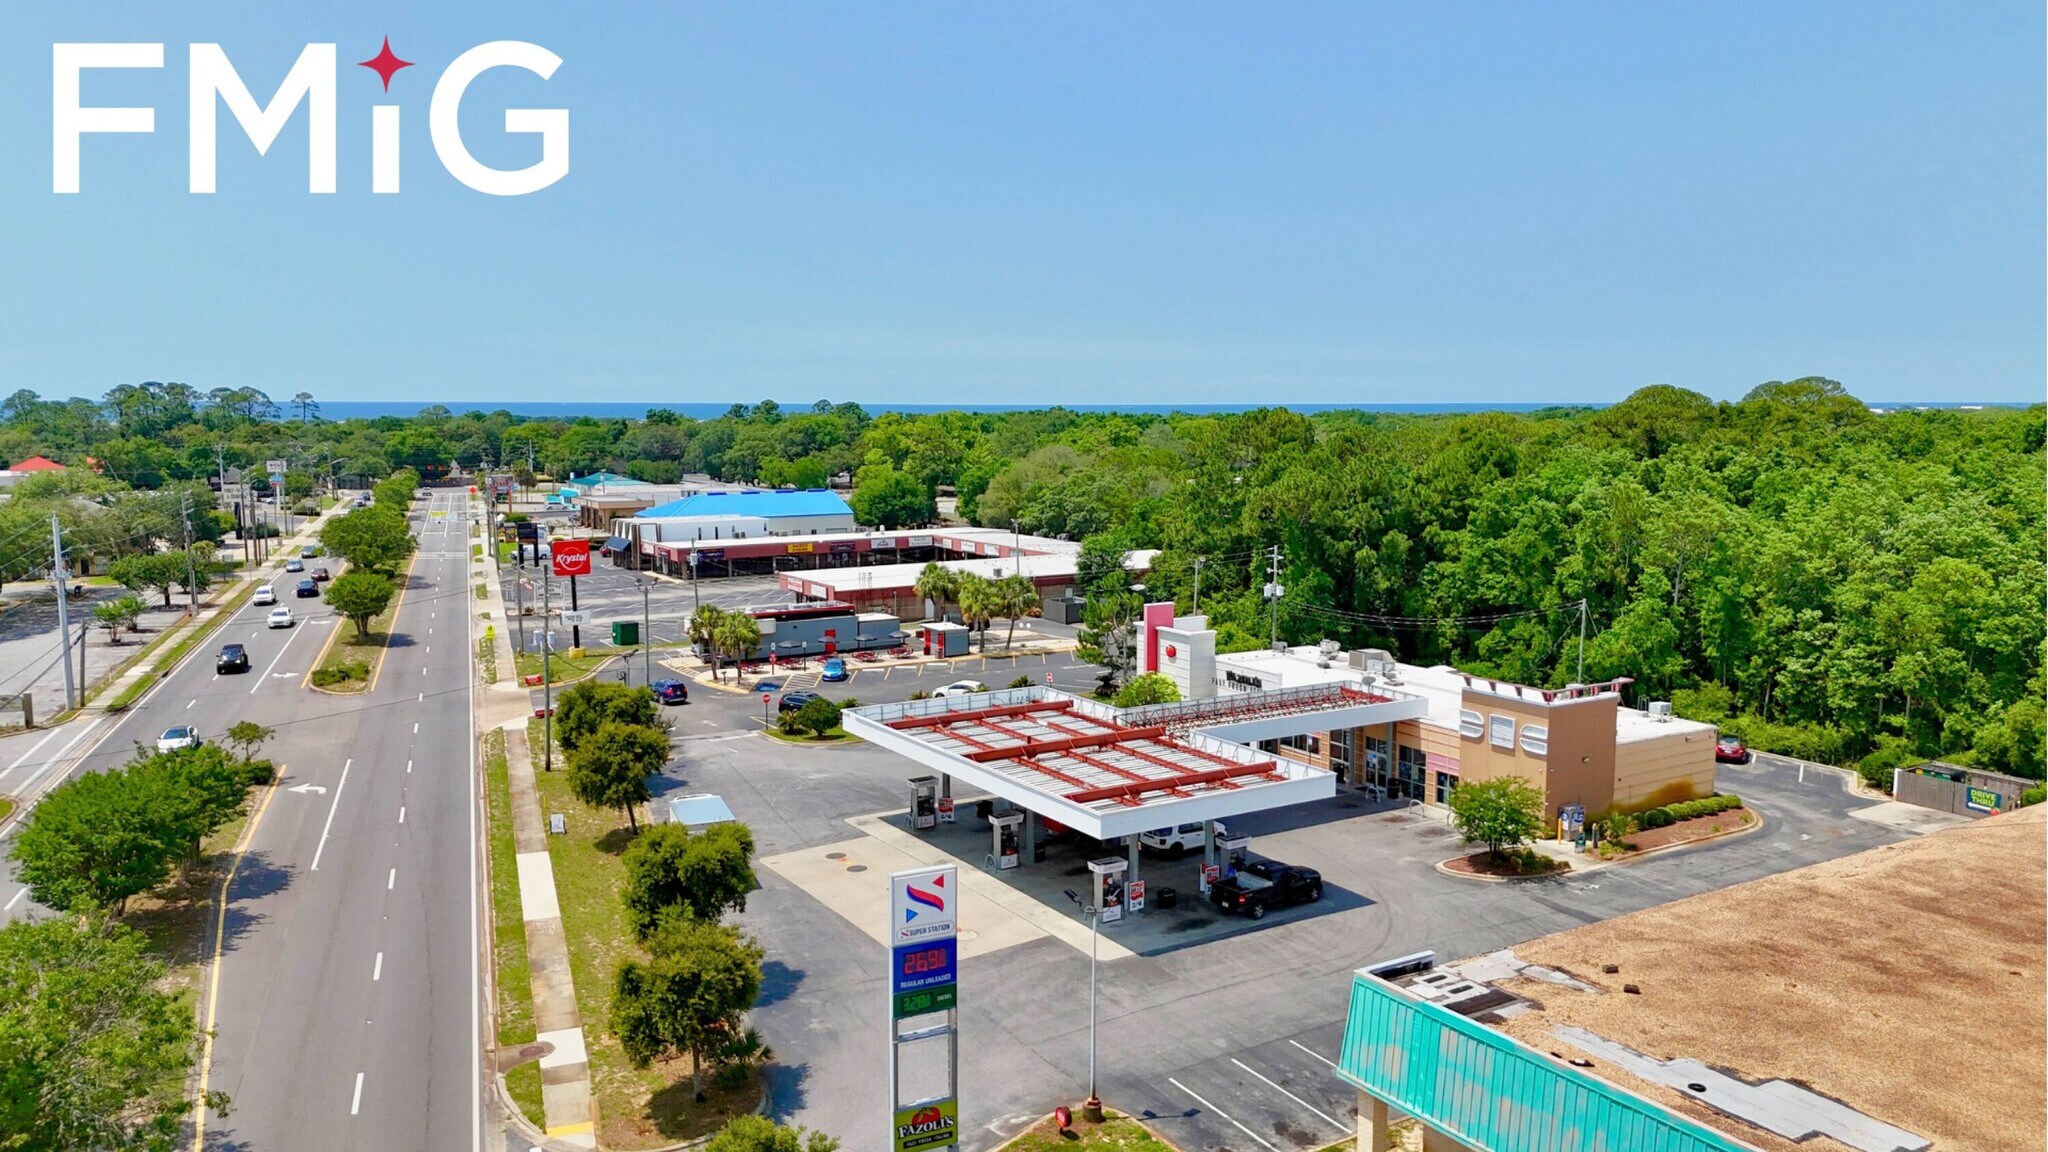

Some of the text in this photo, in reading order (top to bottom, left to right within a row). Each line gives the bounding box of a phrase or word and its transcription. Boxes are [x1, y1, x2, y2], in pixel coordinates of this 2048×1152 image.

[556, 552, 588, 564] Krystal
[1971, 789, 1996, 801] DRIVE
[1972, 796, 1995, 807] THRU
[909, 923, 950, 936] SUPER STATION
[900, 973, 951, 988] REGULAR UNLEADED
[898, 1115, 955, 1139] FAZOLI'S
